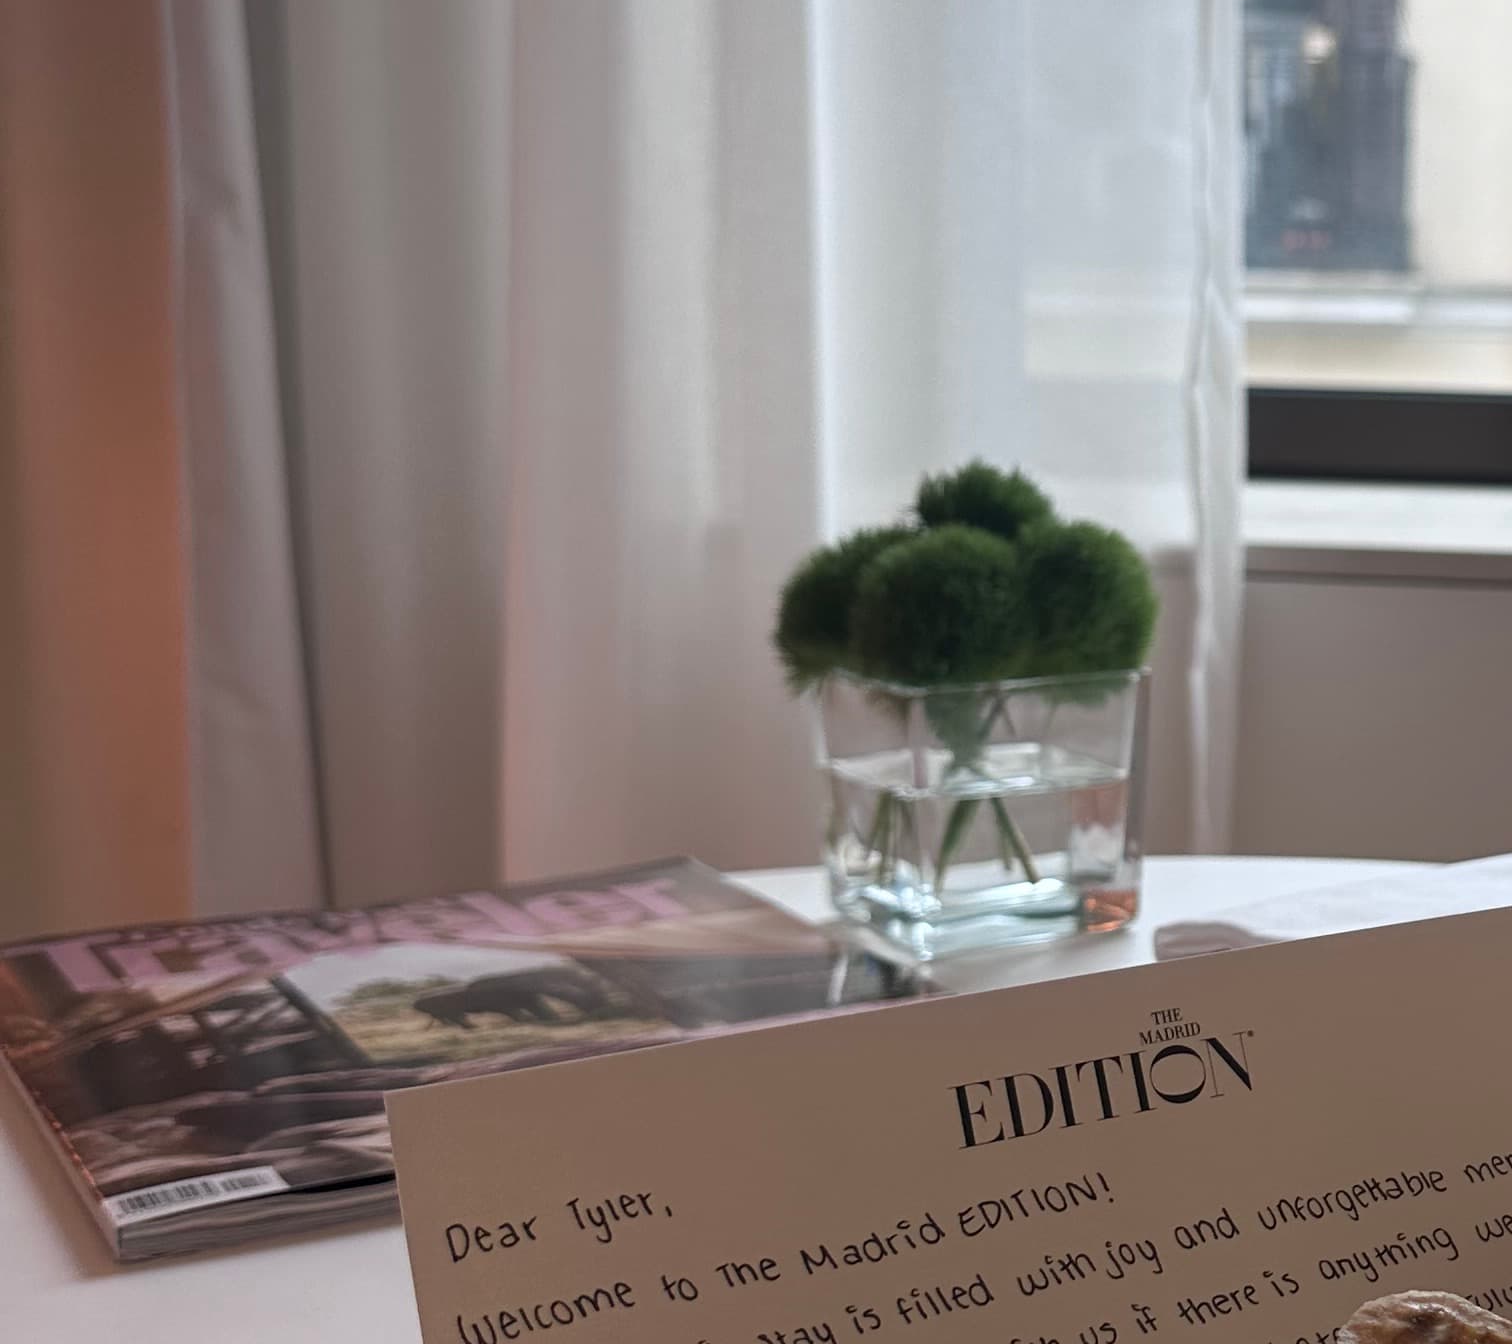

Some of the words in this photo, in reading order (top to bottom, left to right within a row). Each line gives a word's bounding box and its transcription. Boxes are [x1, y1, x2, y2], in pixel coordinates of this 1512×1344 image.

[1139, 1021, 1201, 1046] MADRID
[1151, 1008, 1182, 1025] THE
[947, 1031, 1253, 1150] EDITION
[445, 1214, 537, 1263] Dear
[566, 1190, 673, 1244] Tyler,
[661, 1273, 699, 1303] to
[800, 1212, 946, 1276] Madrid
[957, 1171, 1115, 1238] EDITION!
[846, 1304, 883, 1336] is
[897, 1273, 994, 1326] filled
[1016, 1248, 1097, 1297] with
[1105, 1237, 1163, 1281] joy
[1173, 1207, 1240, 1251] and
[1257, 1166, 1448, 1232] unforgettable
[1131, 1303, 1159, 1336] if
[1177, 1280, 1260, 1327] there
[1263, 1267, 1301, 1299] is
[1317, 1224, 1460, 1284] anything
